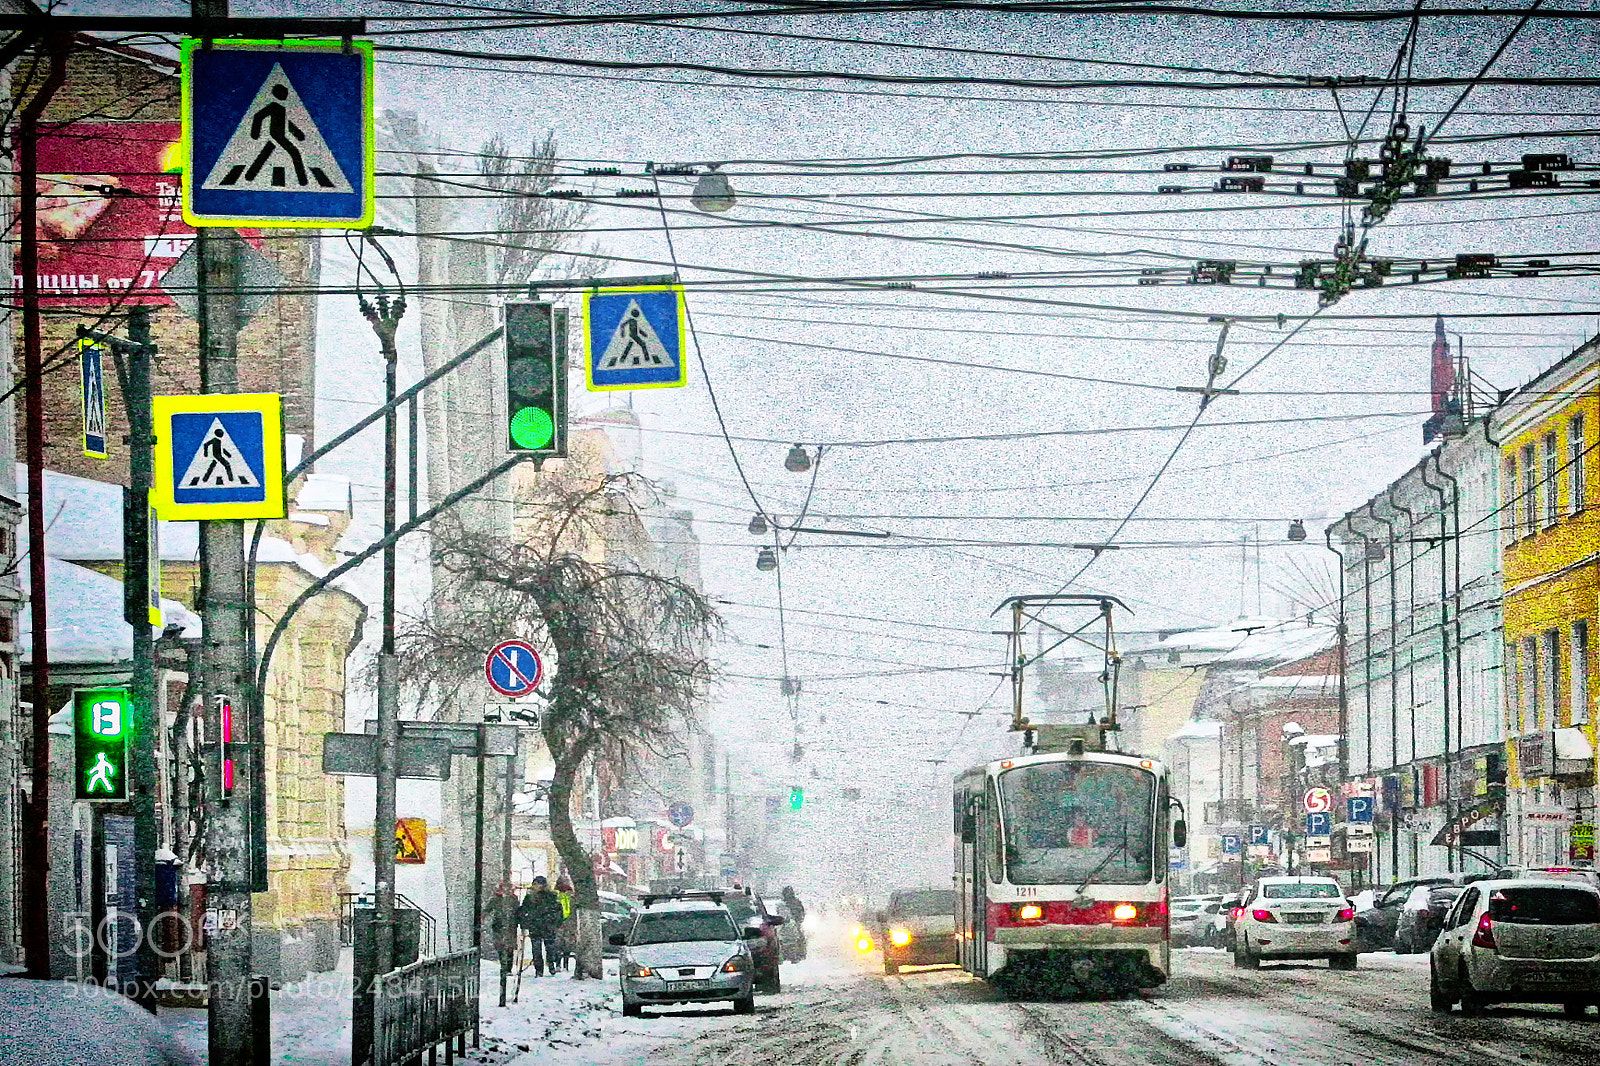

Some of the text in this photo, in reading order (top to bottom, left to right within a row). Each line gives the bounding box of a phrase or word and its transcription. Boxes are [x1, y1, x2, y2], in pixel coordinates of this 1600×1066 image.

[107, 278, 132, 288] от
[1353, 800, 1367, 819] P
[1312, 814, 1324, 832] P
[1016, 887, 1037, 897] 1211
